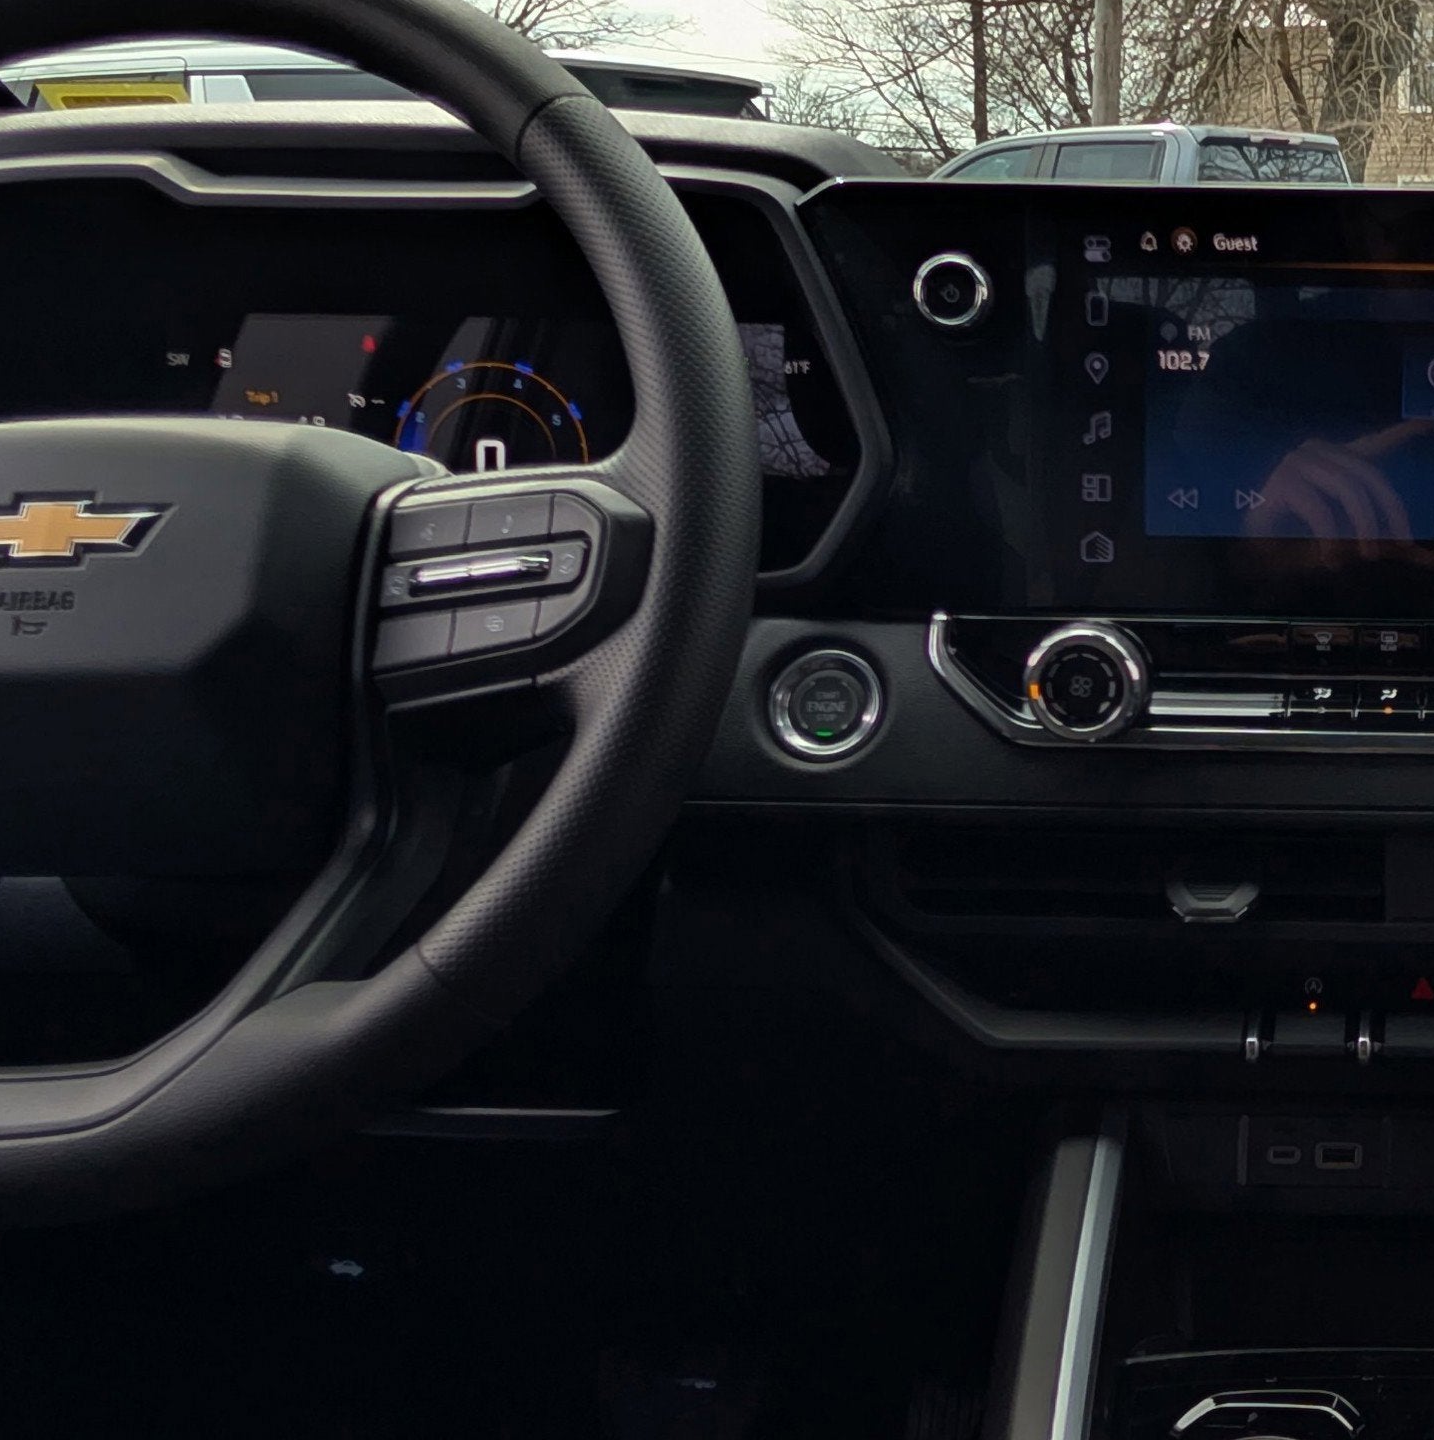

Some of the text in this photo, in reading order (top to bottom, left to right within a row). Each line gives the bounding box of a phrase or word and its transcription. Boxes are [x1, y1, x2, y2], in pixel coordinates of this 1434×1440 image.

[1213, 232, 1258, 251] Guest
[1187, 325, 1211, 340] FM
[1158, 350, 1210, 371] 102.7
